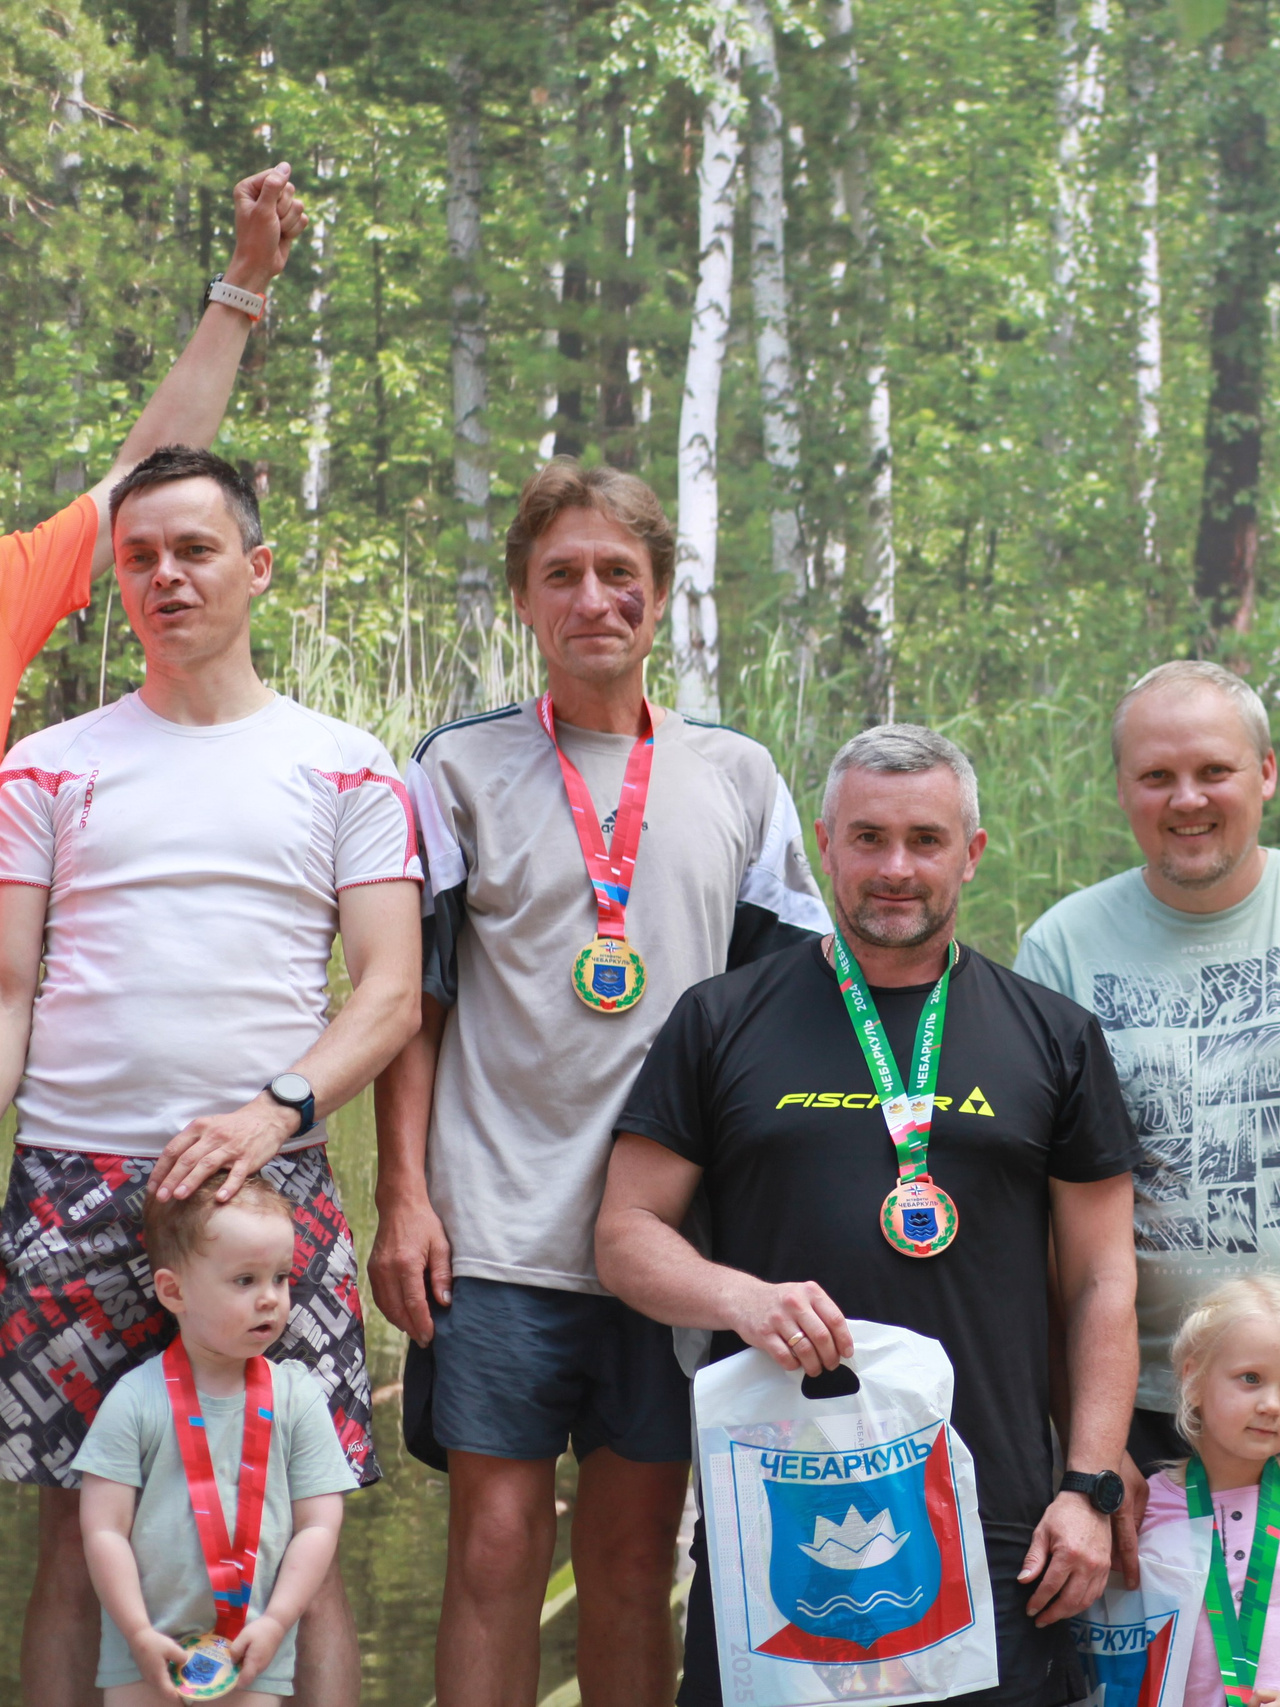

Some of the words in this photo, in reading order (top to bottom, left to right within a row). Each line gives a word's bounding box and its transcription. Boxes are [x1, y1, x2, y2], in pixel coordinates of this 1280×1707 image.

[79, 769, 99, 829] noname
[848, 983, 867, 1012] 2024
[862, 1019, 894, 1092] ЧЕБАРКУЛЬ
[916, 1012, 937, 1089] ЧЕБАРКУЛЬ
[775, 1092, 953, 1111] FISCR
[68, 1180, 113, 1221] SPORT
[897, 1200, 939, 1209] ЧЕБАРКУЛЬ
[293, 1205, 334, 1247] SPORT
[38, 1221, 129, 1284] ACTIVE
[85, 1264, 147, 1331] JOSS
[760, 1438, 932, 1481] ЧЕБАРКУЛЬ
[1069, 1622, 1157, 1652] БАРКУЛЬ
